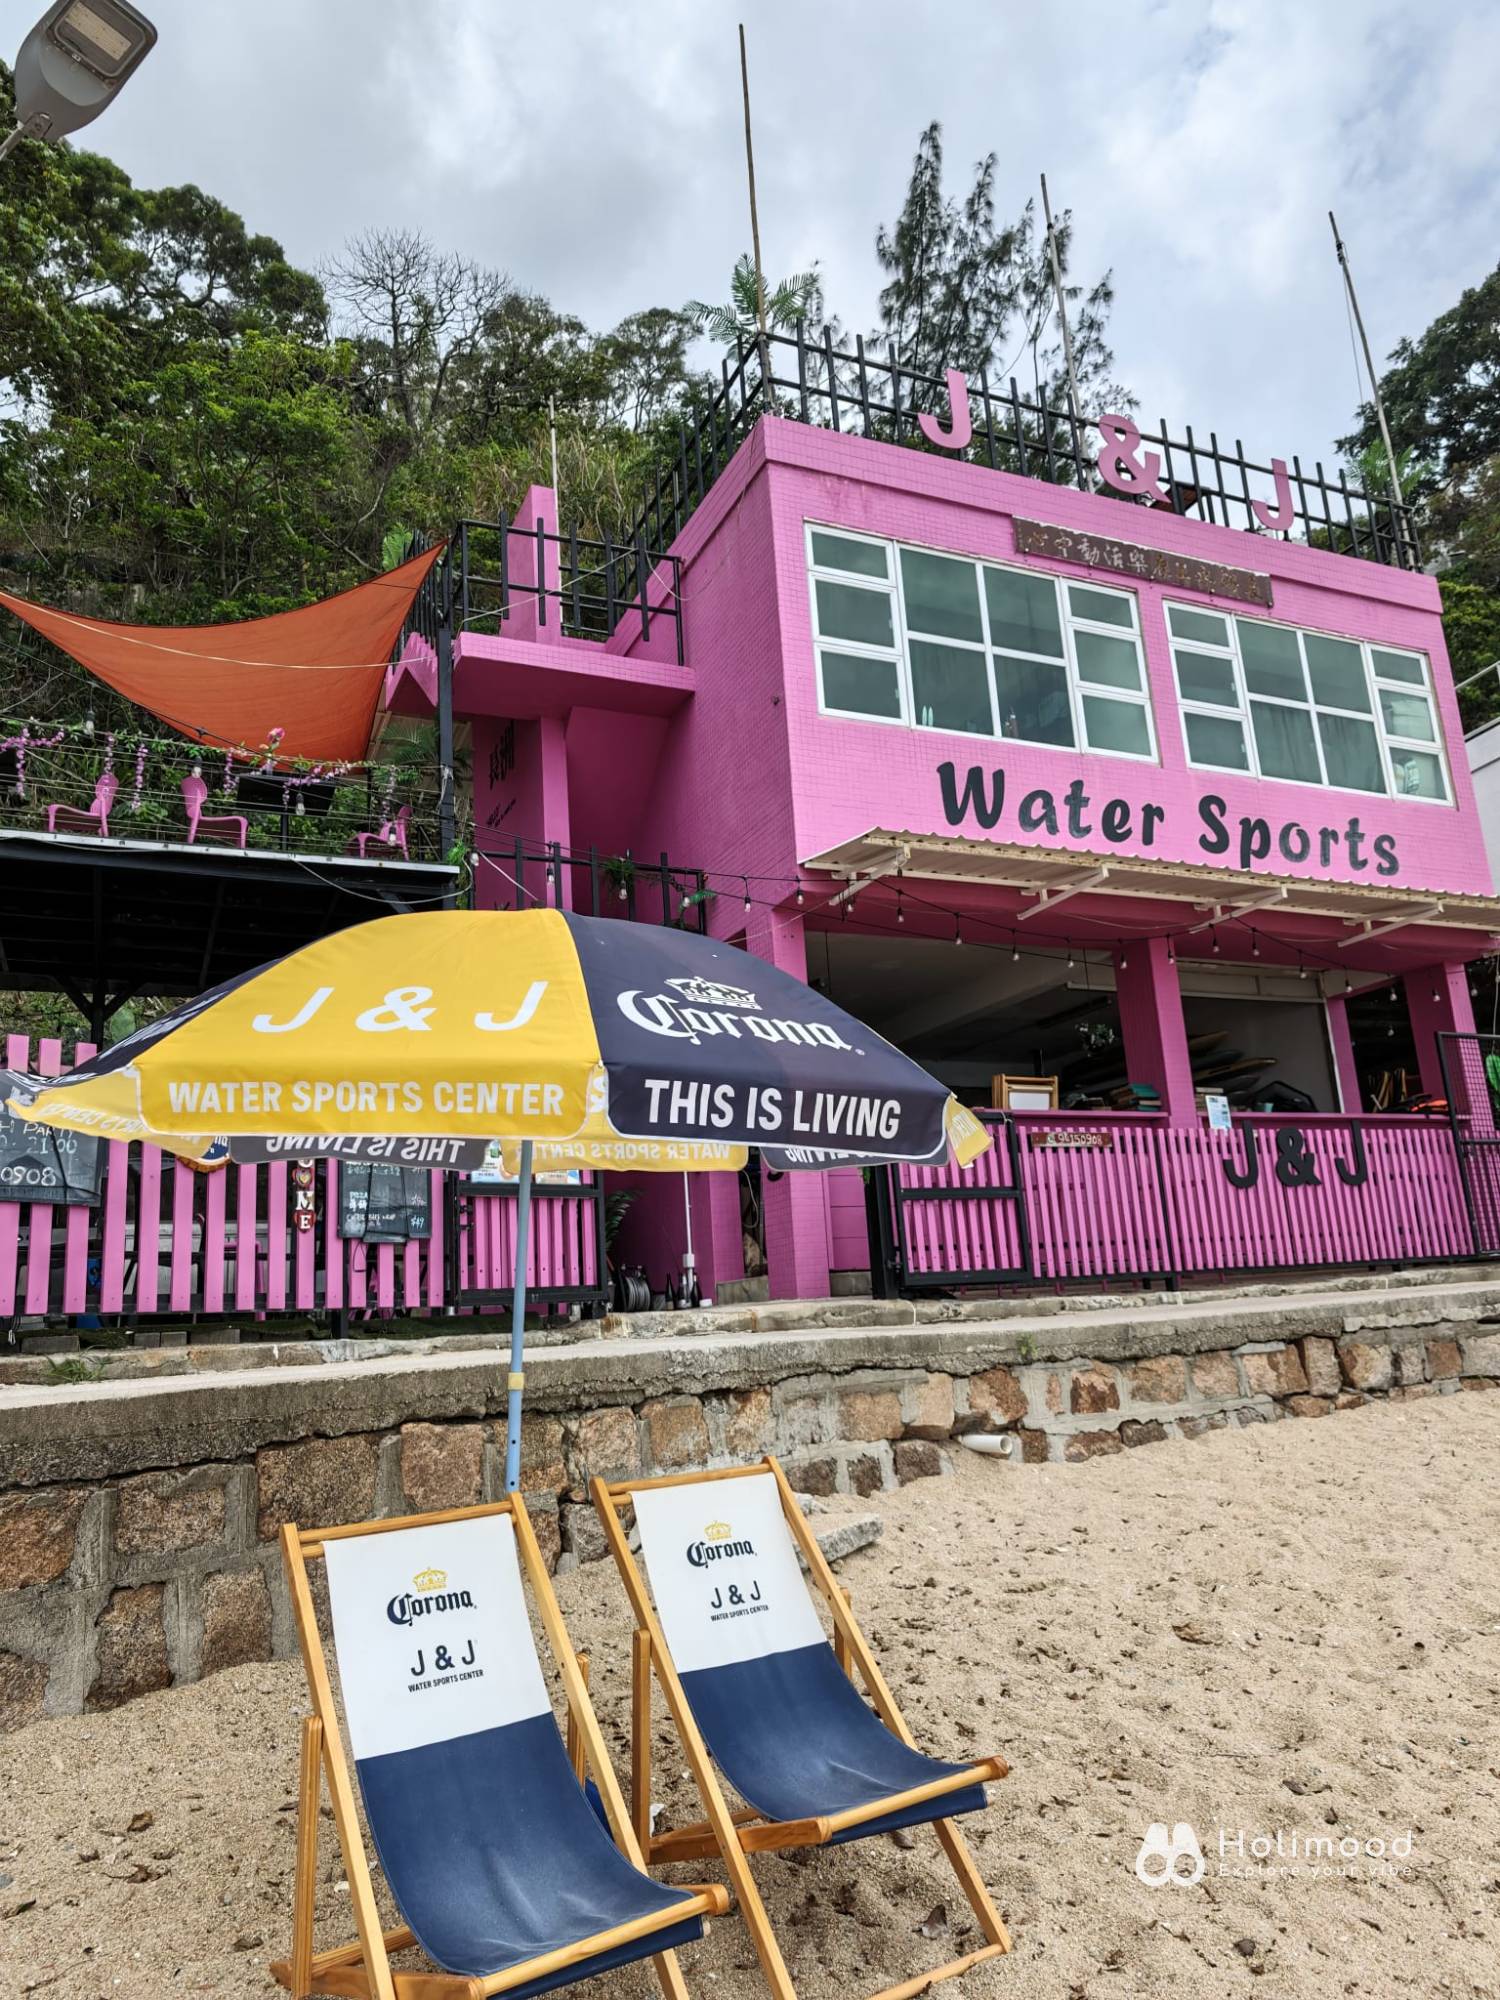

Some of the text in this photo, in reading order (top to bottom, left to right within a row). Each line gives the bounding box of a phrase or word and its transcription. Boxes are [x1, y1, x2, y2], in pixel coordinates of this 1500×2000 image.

[918, 368, 1294, 531] J & J
[937, 761, 1400, 877] Water Sports
[252, 987, 334, 1032] J
[355, 986, 437, 1031] &
[474, 981, 548, 1032] J
[617, 990, 852, 1051] Corona
[169, 1081, 282, 1113] WATER
[292, 1081, 423, 1113] SPORTS
[432, 1082, 564, 1115] CENTER
[644, 1079, 736, 1128] THIS
[746, 1087, 782, 1131] IS
[793, 1090, 900, 1140] LIVING
[1223, 1120, 1368, 1189] J & J
[686, 1537, 754, 1569] Corona
[387, 1589, 474, 1627] Corona
[710, 1604, 769, 1622] WATER SPORTS CENTER
[711, 1580, 762, 1609] J & J
[411, 1639, 476, 1676] J & J
[408, 1668, 484, 1693] WATER SPORTS CENTER
